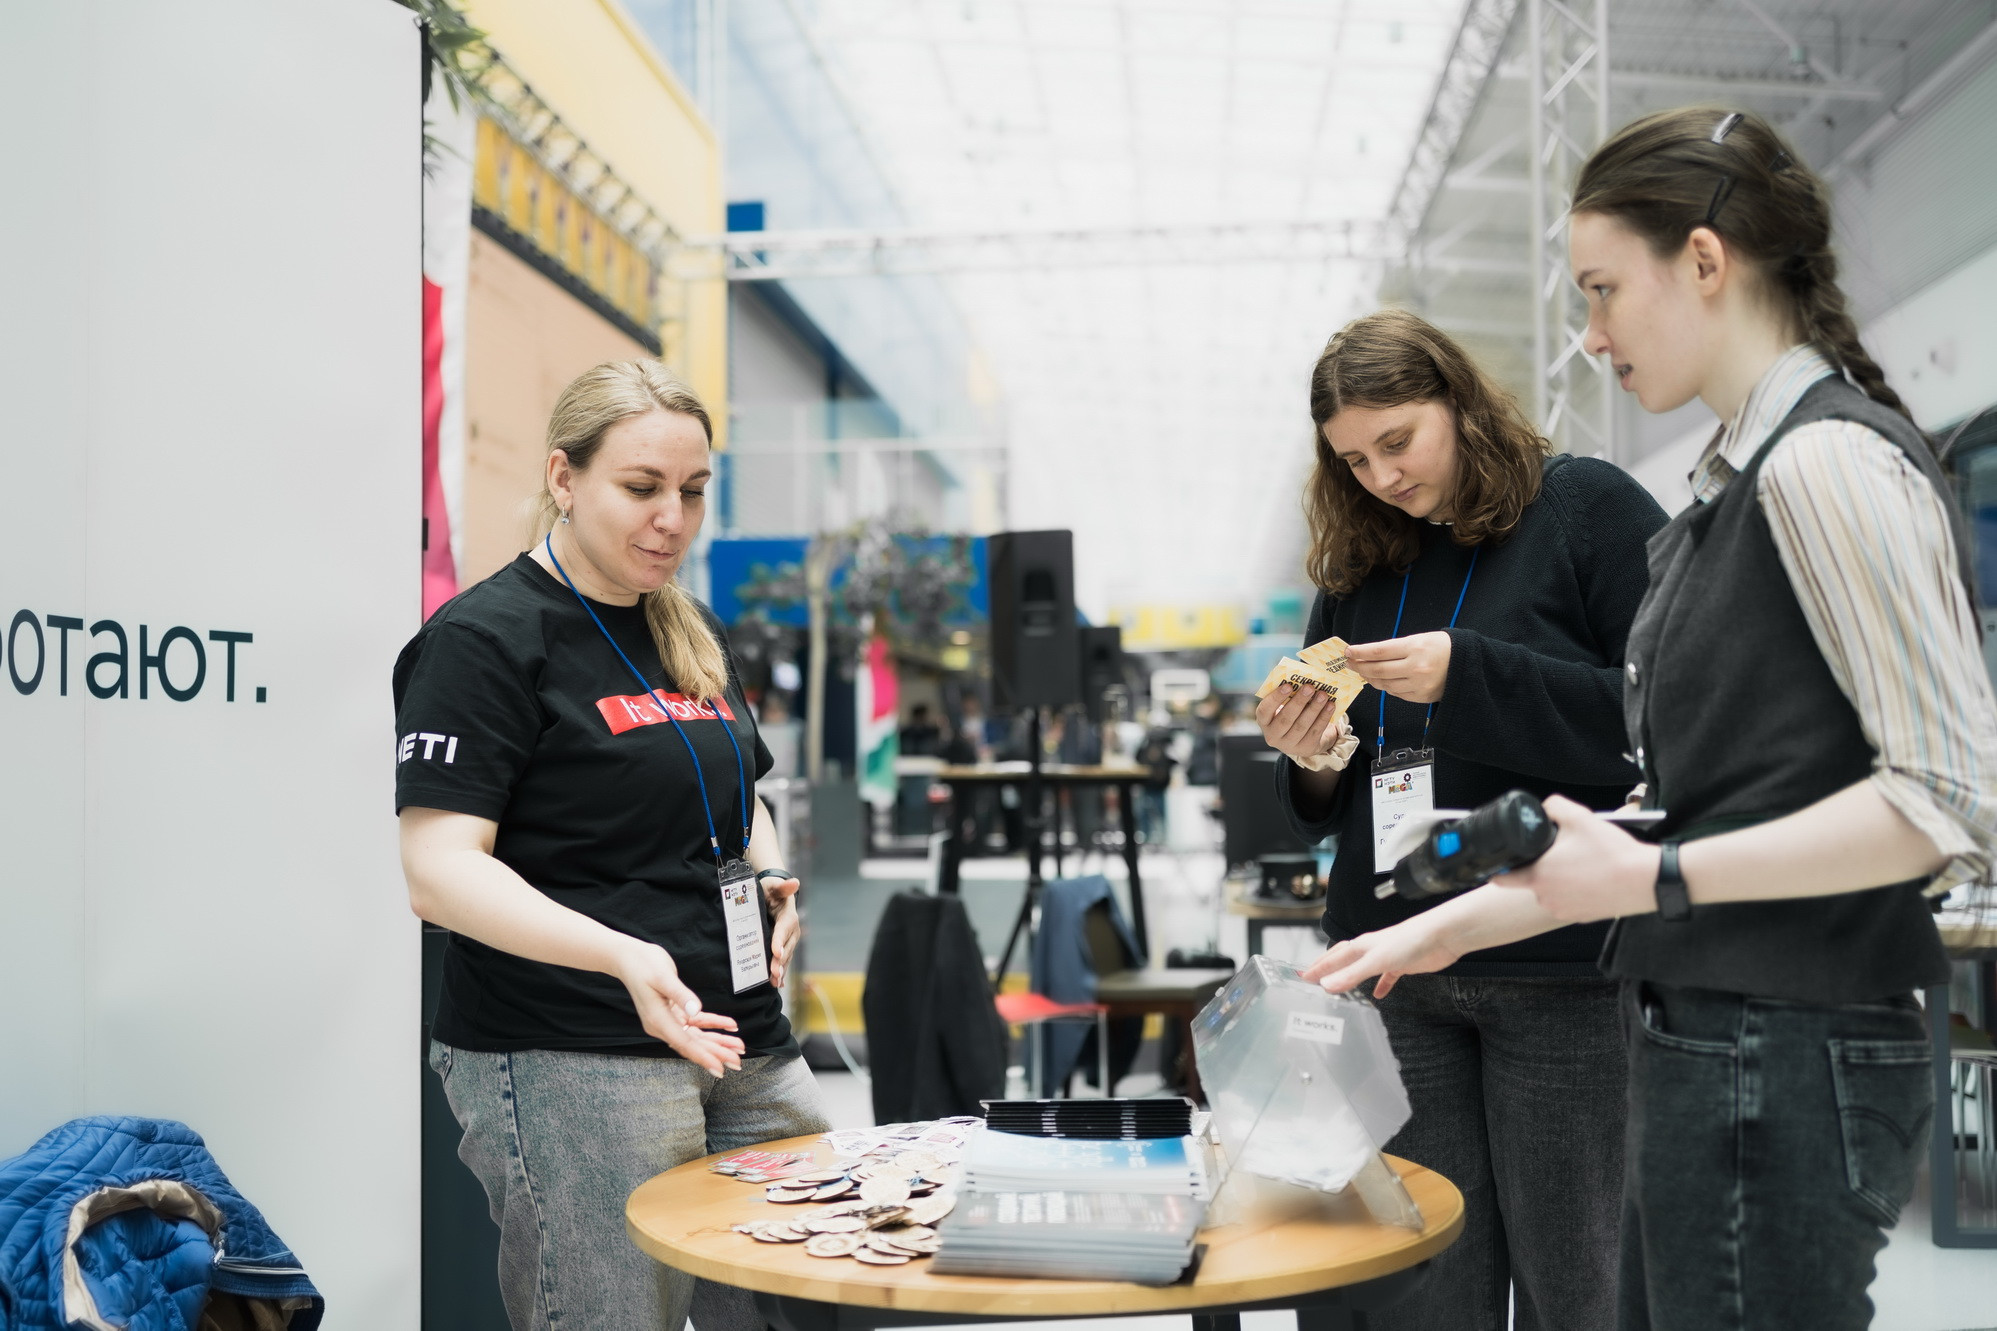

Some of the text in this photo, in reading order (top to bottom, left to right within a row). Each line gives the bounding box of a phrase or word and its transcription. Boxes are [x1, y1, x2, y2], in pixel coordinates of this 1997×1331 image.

[0, 608, 267, 703] отают.
[1290, 674, 1338, 695] СЕКРЕТНАЯ
[620, 698, 652, 722] It
